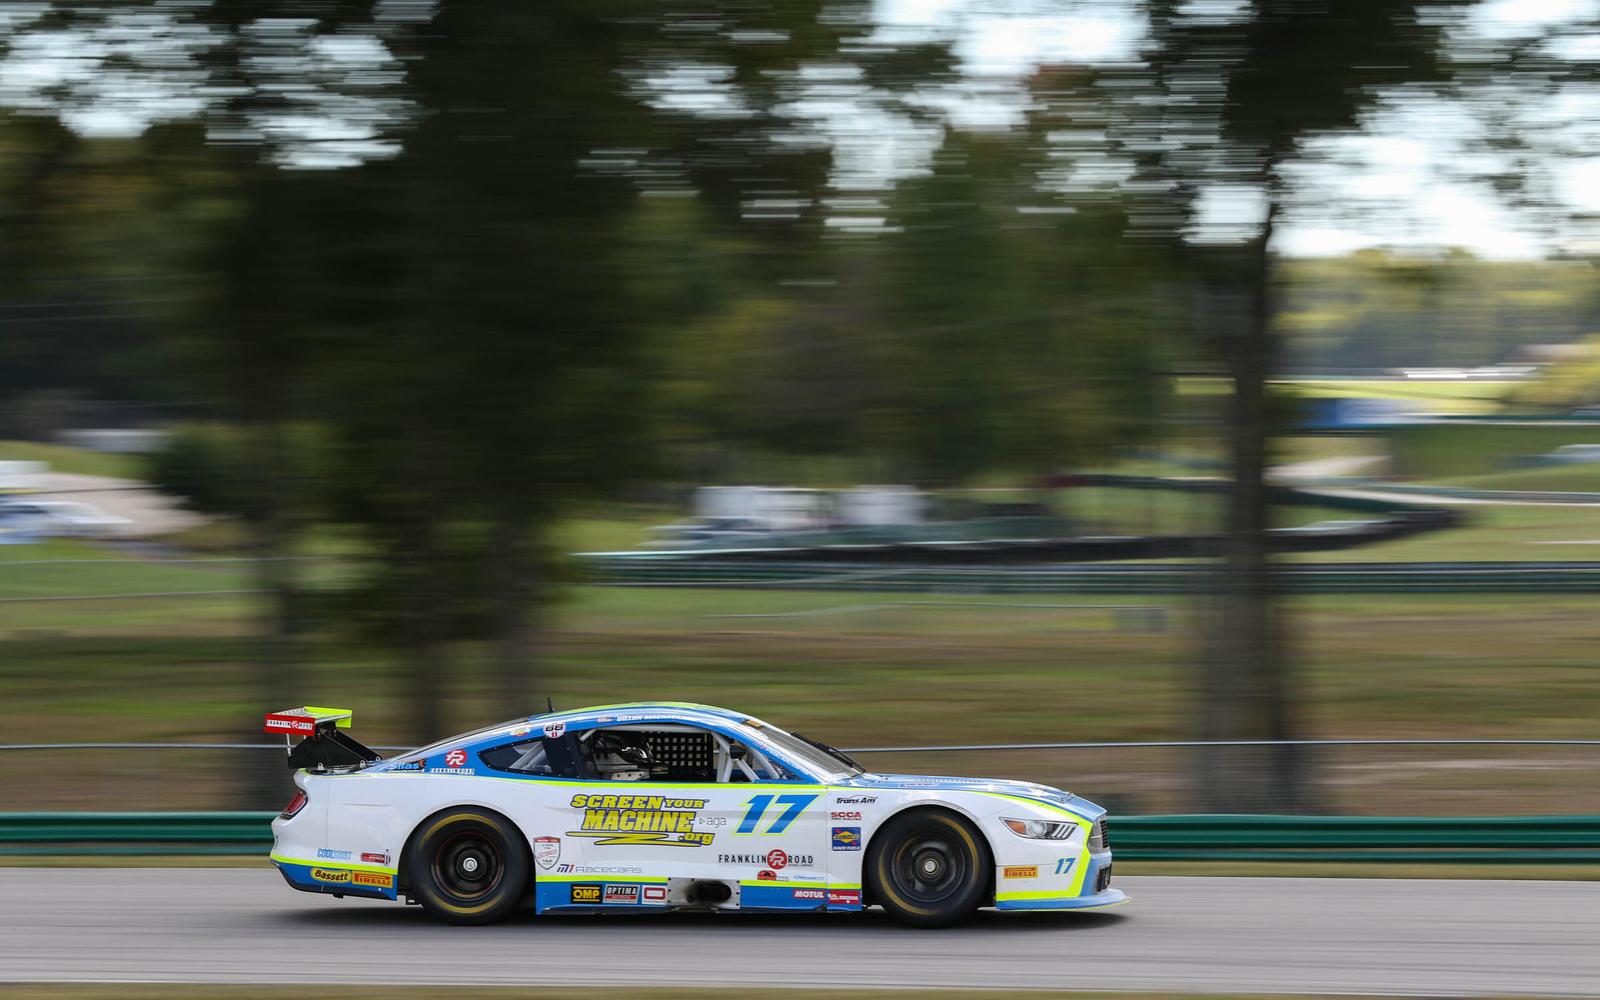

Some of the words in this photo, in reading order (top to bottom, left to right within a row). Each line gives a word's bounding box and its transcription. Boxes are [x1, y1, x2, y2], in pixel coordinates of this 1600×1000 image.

[570, 794, 665, 809] SCREEN
[664, 799, 705, 809] YOUR
[860, 796, 876, 804] Am
[734, 793, 822, 835] 17
[581, 809, 696, 833] MACHINE
[677, 832, 716, 846] .org
[718, 854, 767, 864] FRANKLIN
[787, 854, 814, 864] ROAD
[1055, 857, 1076, 875] 17
[314, 869, 349, 881] Bassett
[1004, 867, 1037, 878] PIRELLI
[354, 872, 391, 886] PIRELLI
[573, 889, 600, 899] OMP
[607, 886, 637, 895] OPTIMA
[794, 890, 825, 899] MOTUL
